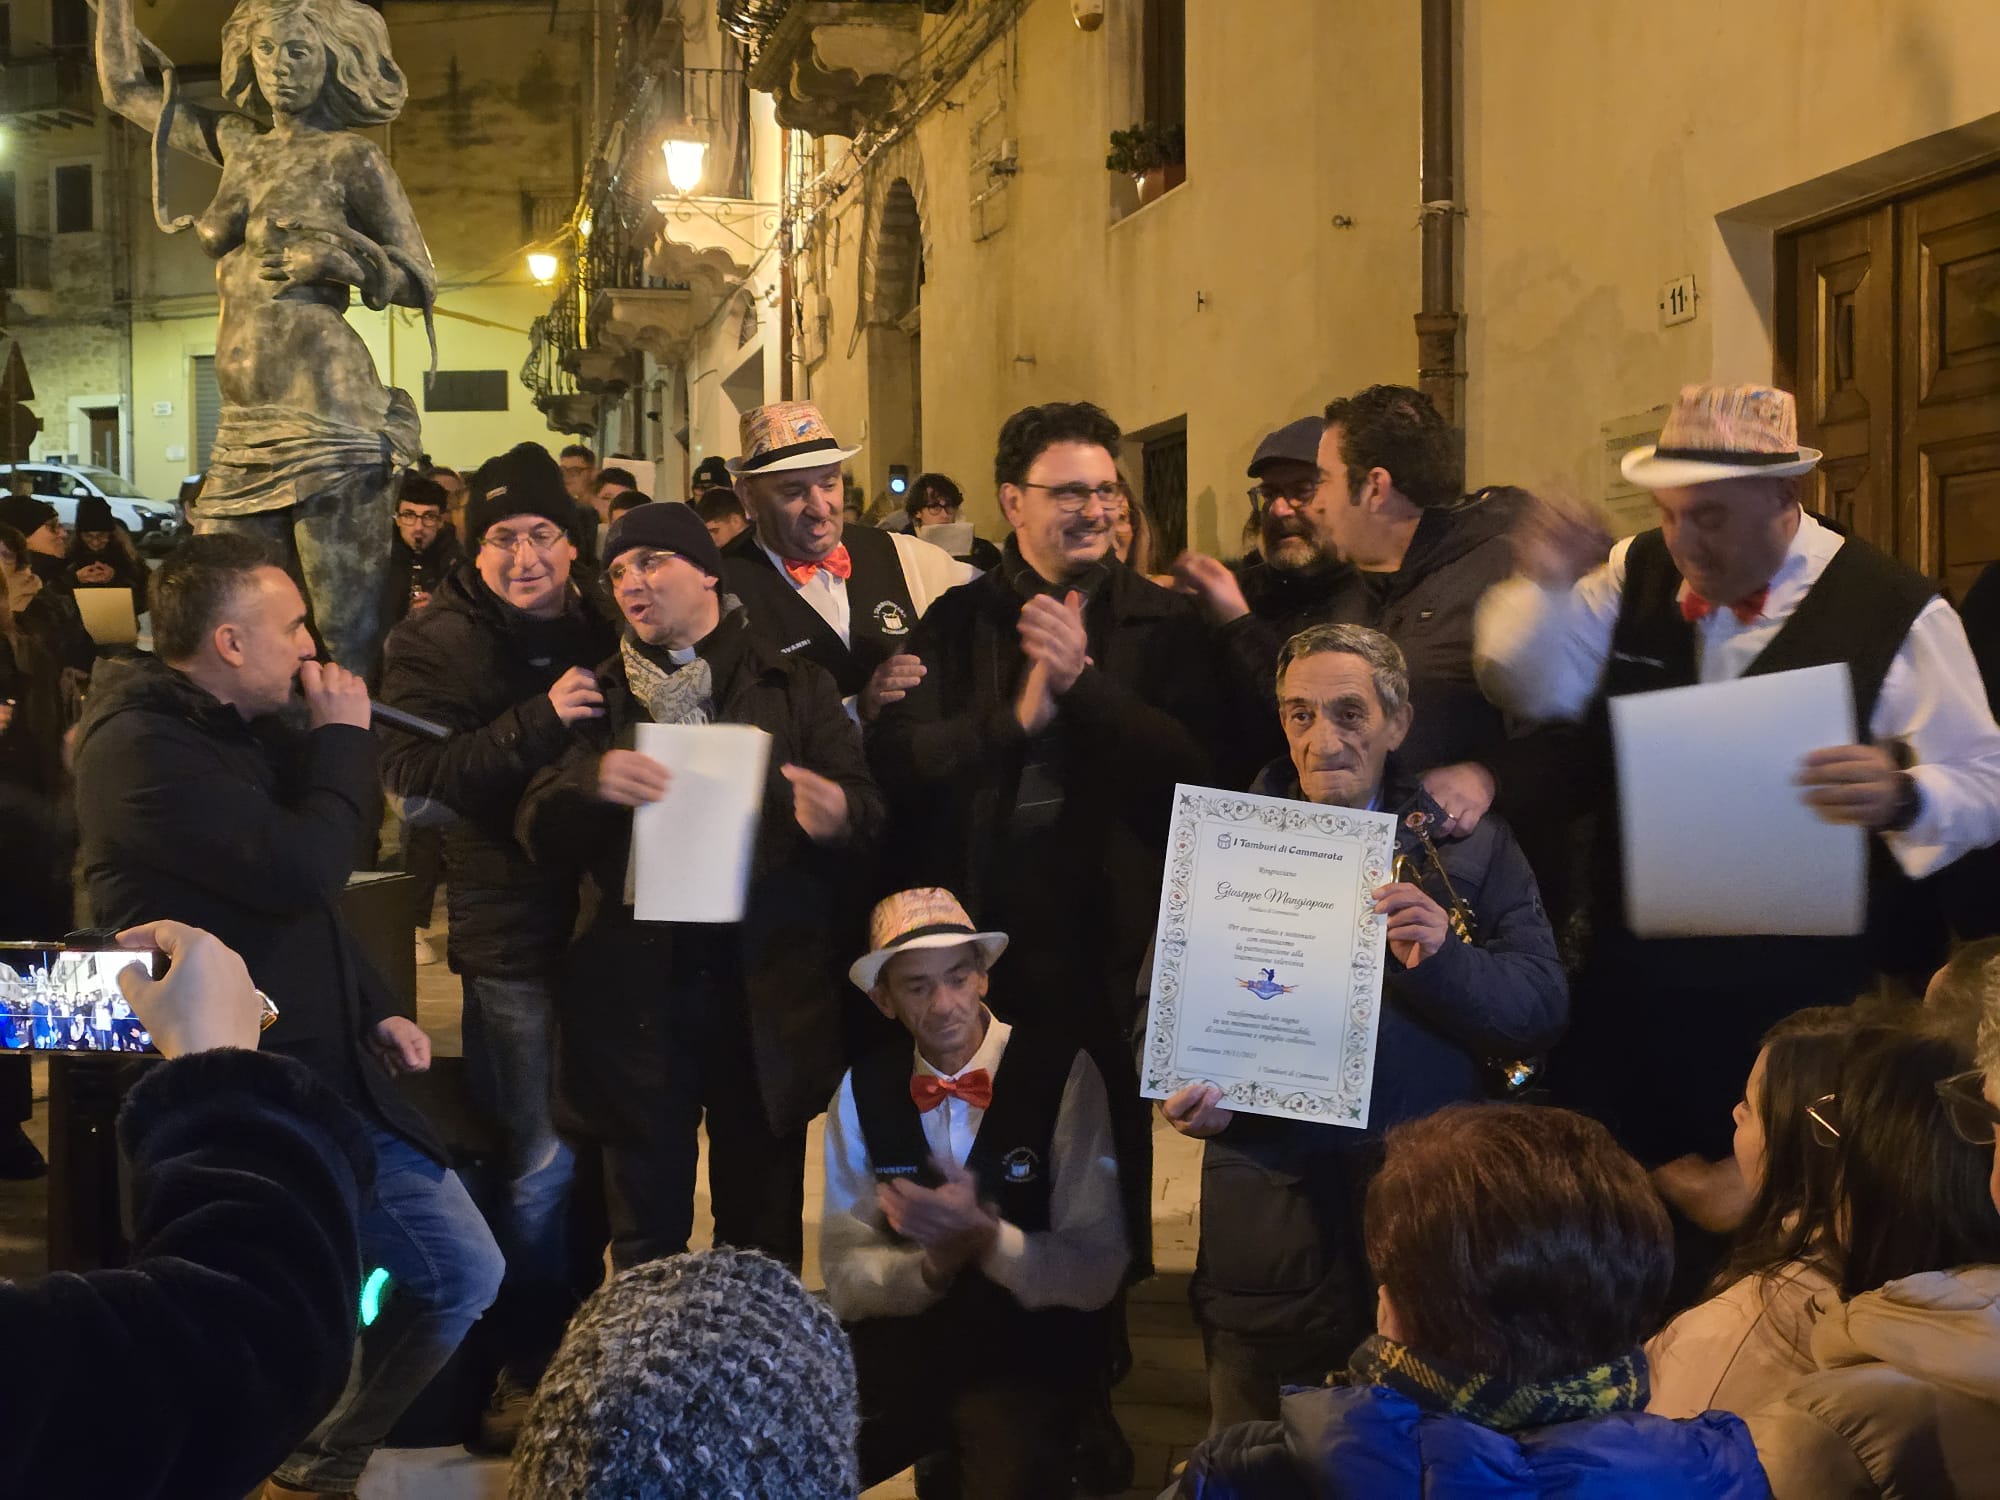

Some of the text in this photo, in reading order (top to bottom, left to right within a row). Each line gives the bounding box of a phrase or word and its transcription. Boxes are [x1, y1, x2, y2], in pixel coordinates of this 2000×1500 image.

[1670, 285, 1684, 315] 11
[1233, 838, 1344, 861] I Tamburi di Cammarata
[1214, 880, 1335, 911] Giuseppe Mangiapane
